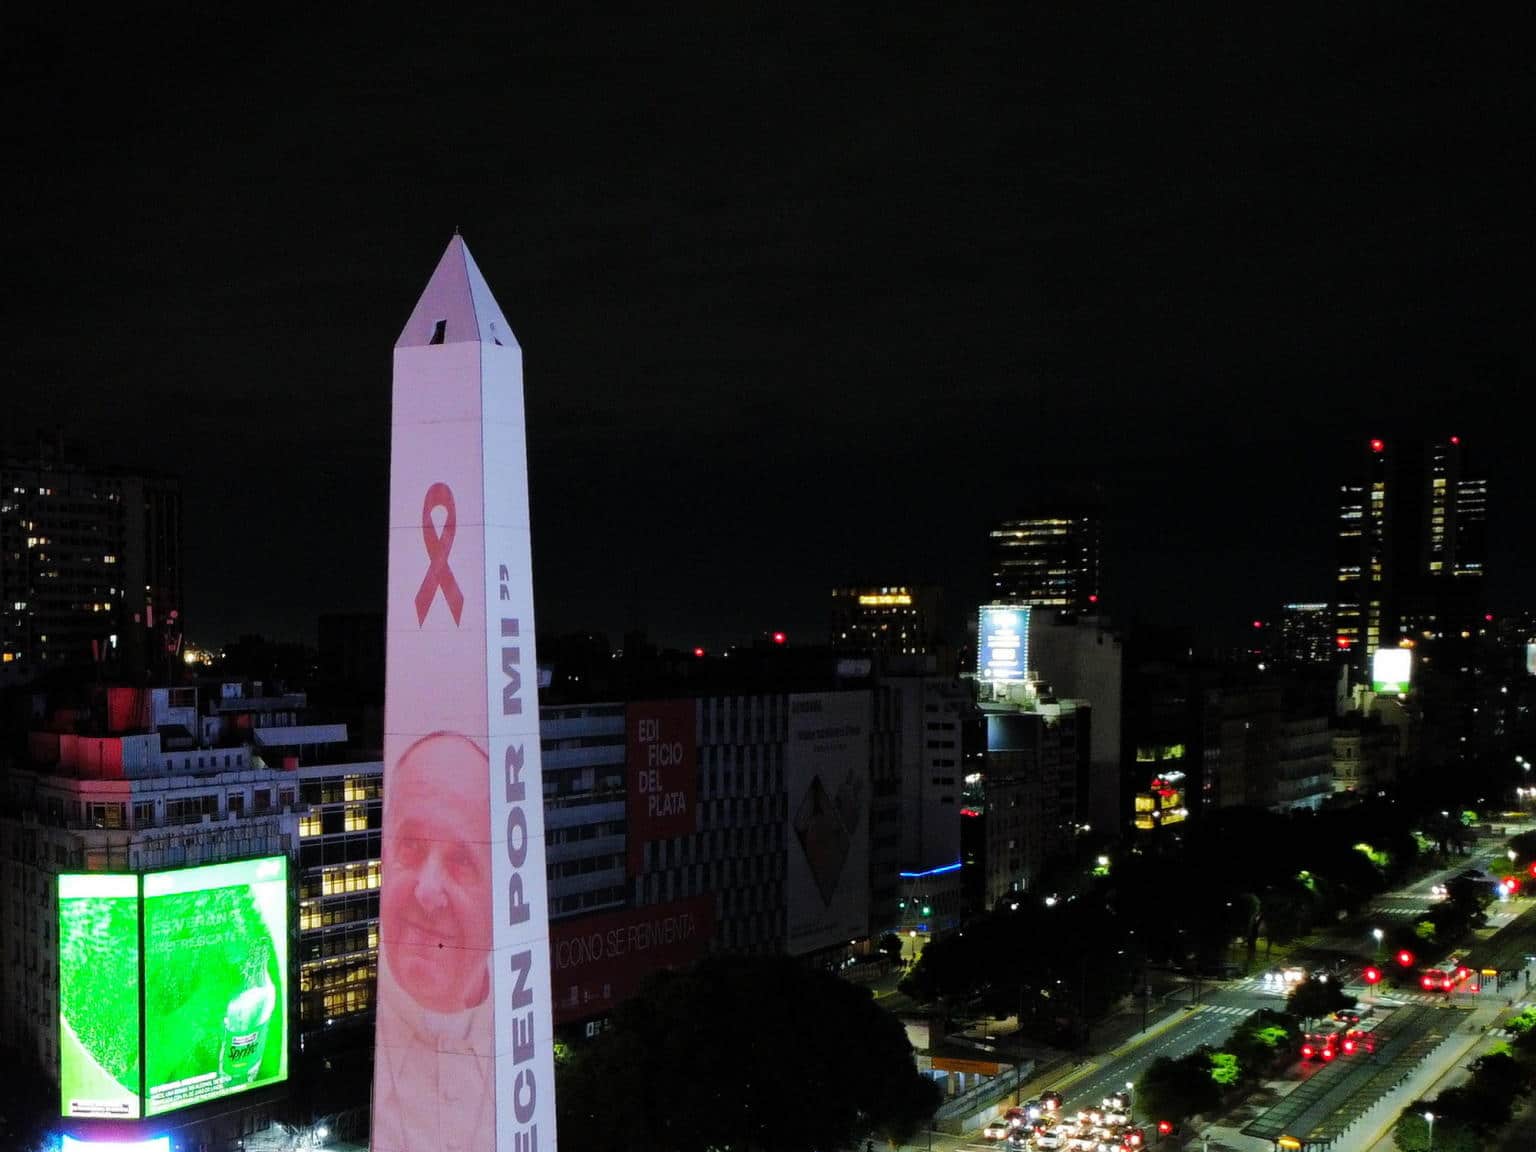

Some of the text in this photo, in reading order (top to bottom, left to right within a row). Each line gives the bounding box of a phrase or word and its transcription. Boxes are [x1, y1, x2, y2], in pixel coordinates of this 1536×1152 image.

[637, 719, 660, 743] EDI
[647, 742, 683, 768] FICIO
[638, 768, 663, 794] DEL
[647, 791, 688, 817] PLATA
[505, 744, 532, 927] POR
[556, 913, 697, 970] ICONO SE REINVENTA
